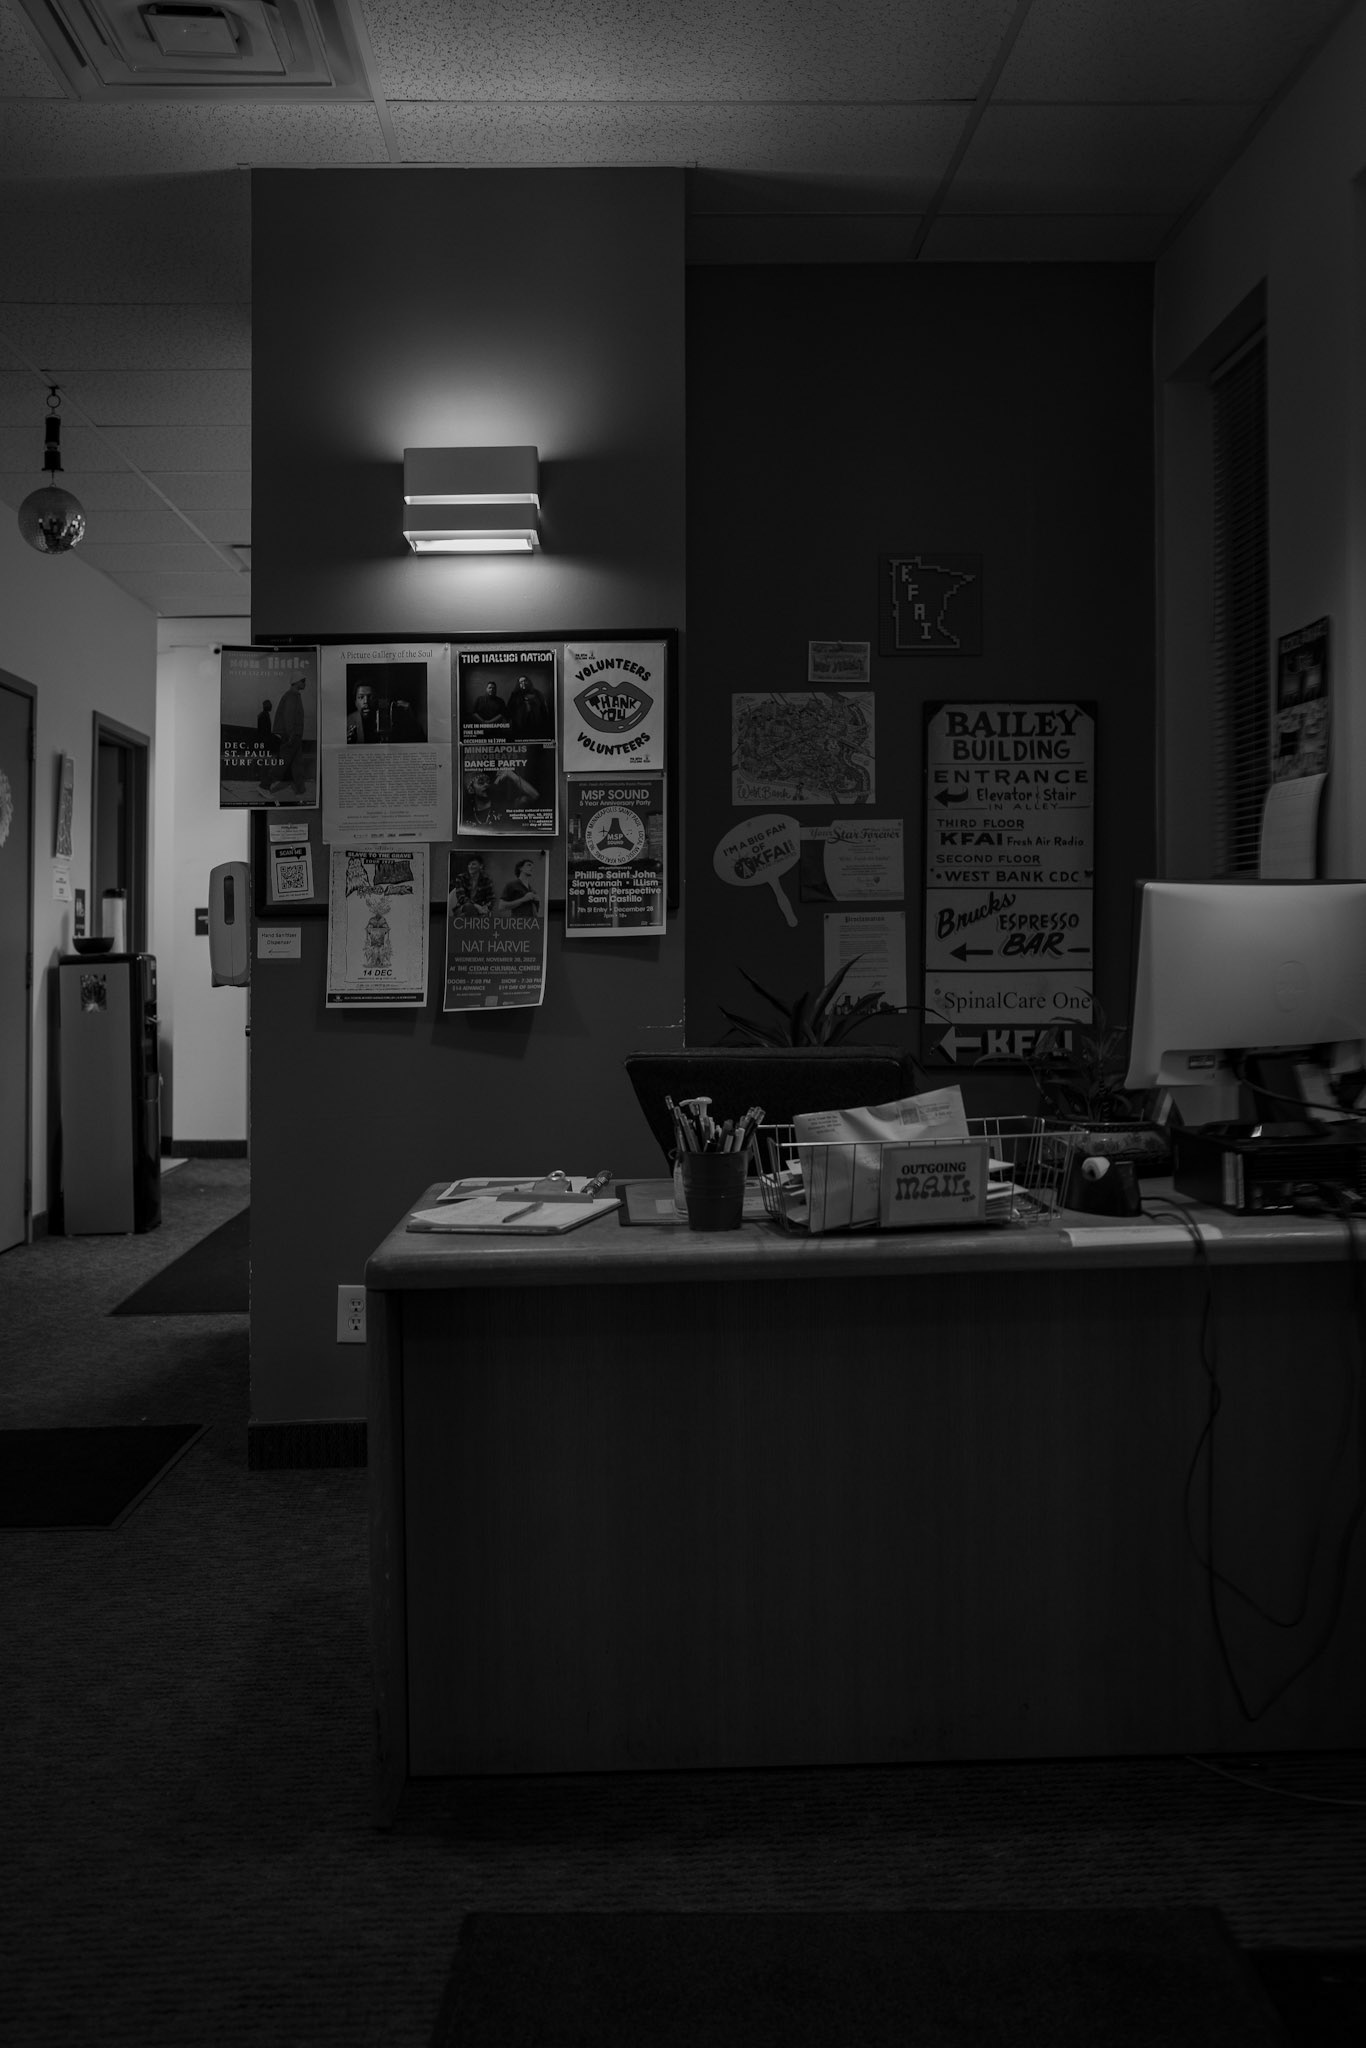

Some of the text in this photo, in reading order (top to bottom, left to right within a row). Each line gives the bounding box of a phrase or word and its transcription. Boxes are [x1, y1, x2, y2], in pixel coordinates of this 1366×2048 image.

[372, 651, 396, 660] Gallery
[398, 650, 404, 658] of
[405, 650, 416, 658] the
[417, 650, 432, 658] Soul
[575, 658, 651, 682] VOLUNTEERS
[588, 695, 637, 710] THANK
[599, 708, 626, 721] YOU
[944, 710, 1082, 737] BAILEY
[577, 732, 650, 756] VOLUNTEERS
[953, 739, 1071, 761] BUILDING
[934, 770, 1088, 785] ENTRANCE
[581, 789, 649, 800] MSP SOUND
[976, 786, 1032, 802] Elevator
[1043, 786, 1077, 801] Stair
[589, 807, 617, 829] MINNEAPOLIS
[936, 819, 1025, 829] THIRD FLOOR
[723, 822, 786, 856] I'M A BIG FAN
[940, 832, 1084, 846] KFAI Fresh Air Radio
[752, 842, 765, 853] OF
[936, 855, 1040, 864] SECOND FLOOR
[575, 870, 656, 880] Phillip Saint John
[944, 870, 1079, 882] WEST BANK CDC
[572, 879, 622, 888] Slayvannah
[610, 894, 642, 902] Castillo
[611, 887, 661, 896] Perspective
[453, 917, 540, 930] CHRIS PUREKA
[998, 913, 1079, 932] ESPRESSO
[462, 940, 530, 952] NAT HARVIE
[1000, 932, 1064, 957] BAR
[944, 991, 1090, 1013] SpinalCare One
[901, 1162, 967, 1175] OUTGOING
